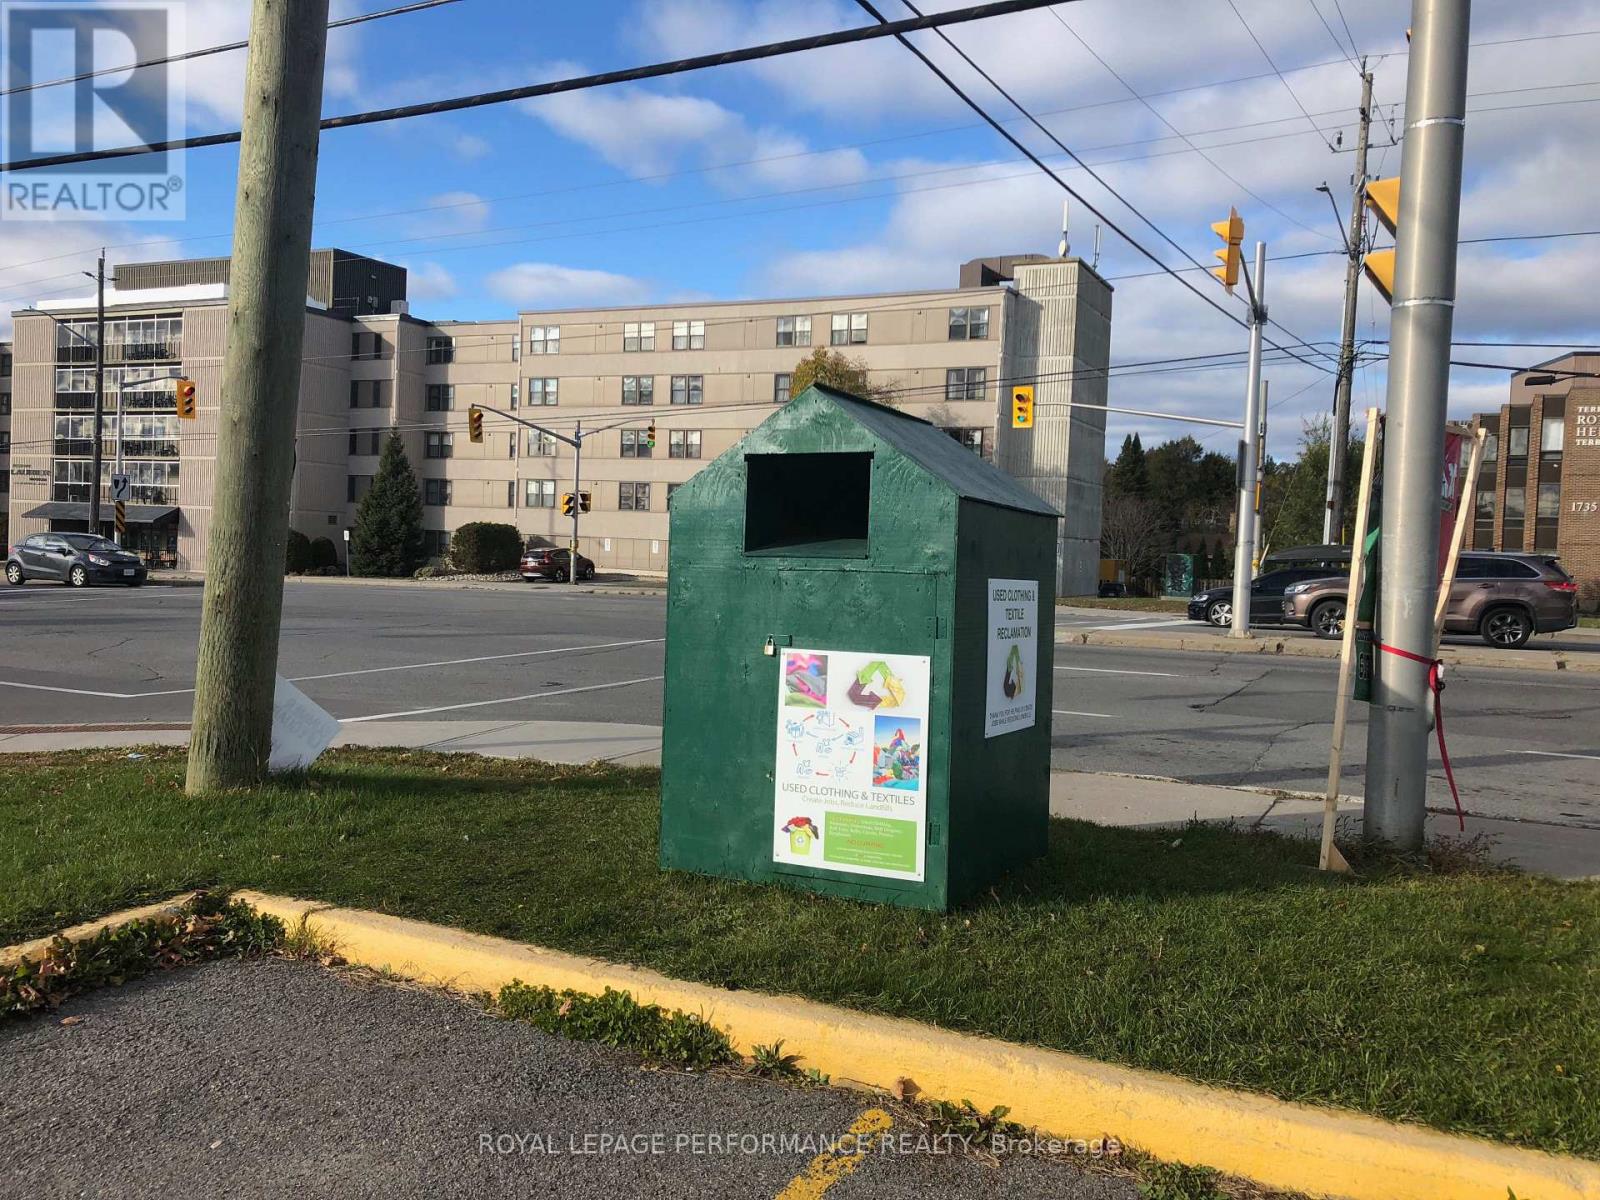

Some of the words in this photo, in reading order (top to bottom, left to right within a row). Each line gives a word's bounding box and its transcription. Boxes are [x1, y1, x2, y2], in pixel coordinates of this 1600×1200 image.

[1571, 501, 1598, 512] 1735
[992, 589, 1007, 602] USED
[1007, 589, 1032, 602] CLOTHING
[1005, 608, 1025, 621] TEXTILE
[997, 626, 1032, 640] RECLAMATION
[782, 783, 807, 793] USED
[808, 785, 859, 800] CLOTHING
[861, 791, 869, 800] &
[871, 792, 915, 806] TEXTILES
